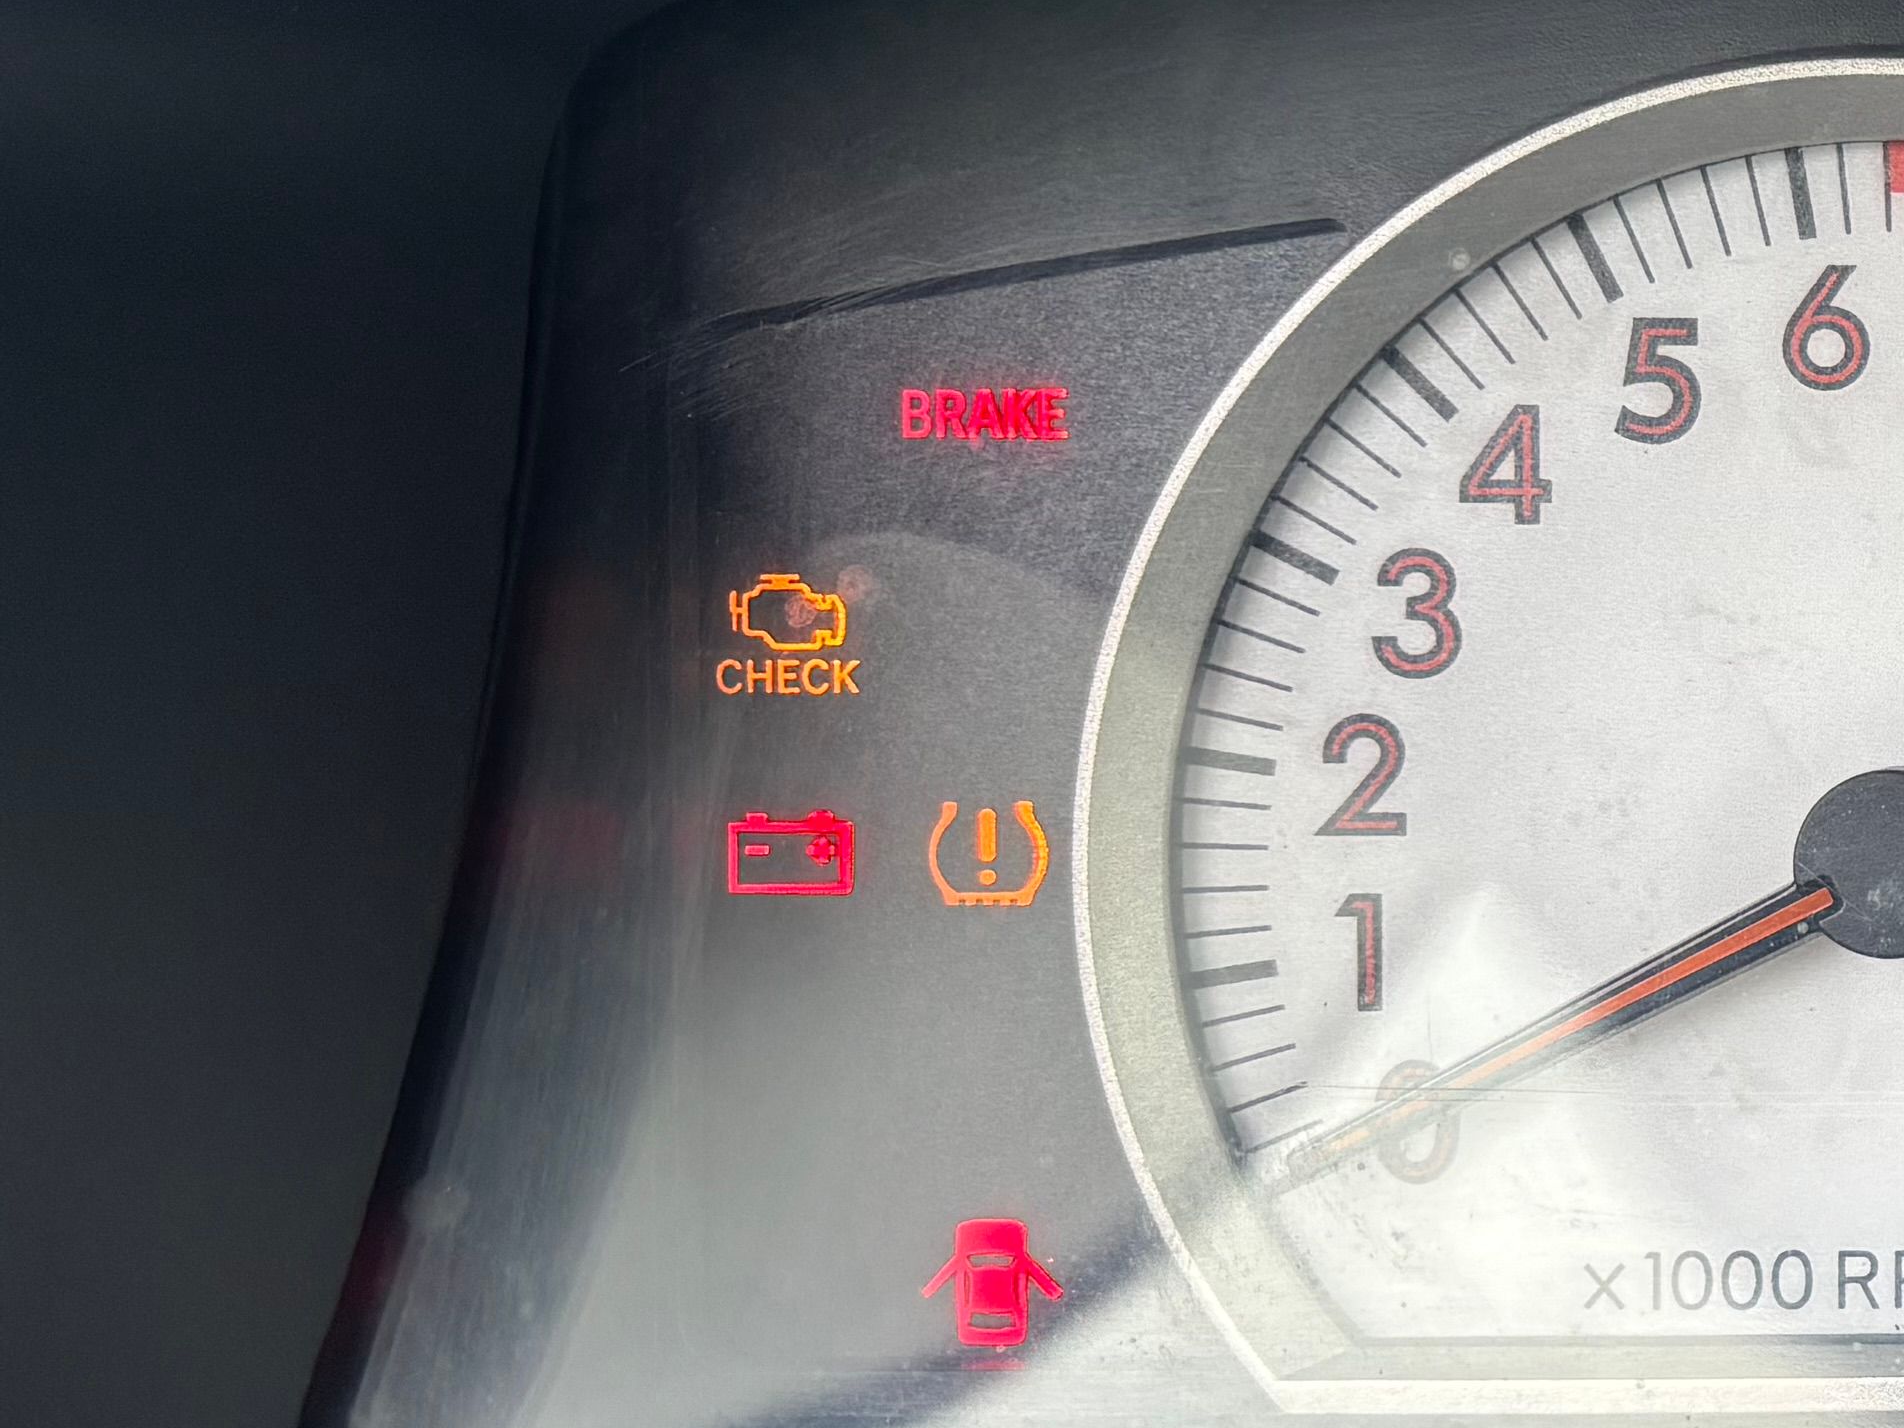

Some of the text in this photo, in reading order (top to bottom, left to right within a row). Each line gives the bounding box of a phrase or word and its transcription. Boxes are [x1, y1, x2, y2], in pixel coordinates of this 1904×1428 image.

[1614, 317, 1701, 443] 5
[1782, 264, 1870, 391] 6
[902, 388, 1069, 441] BRAKE
[1459, 404, 1552, 525] 4
[1371, 547, 1461, 679] 3
[716, 659, 859, 695] CHECK
[1314, 713, 1407, 836] 2
[1335, 893, 1382, 1011] 1
[1376, 1060, 1458, 1184] 0
